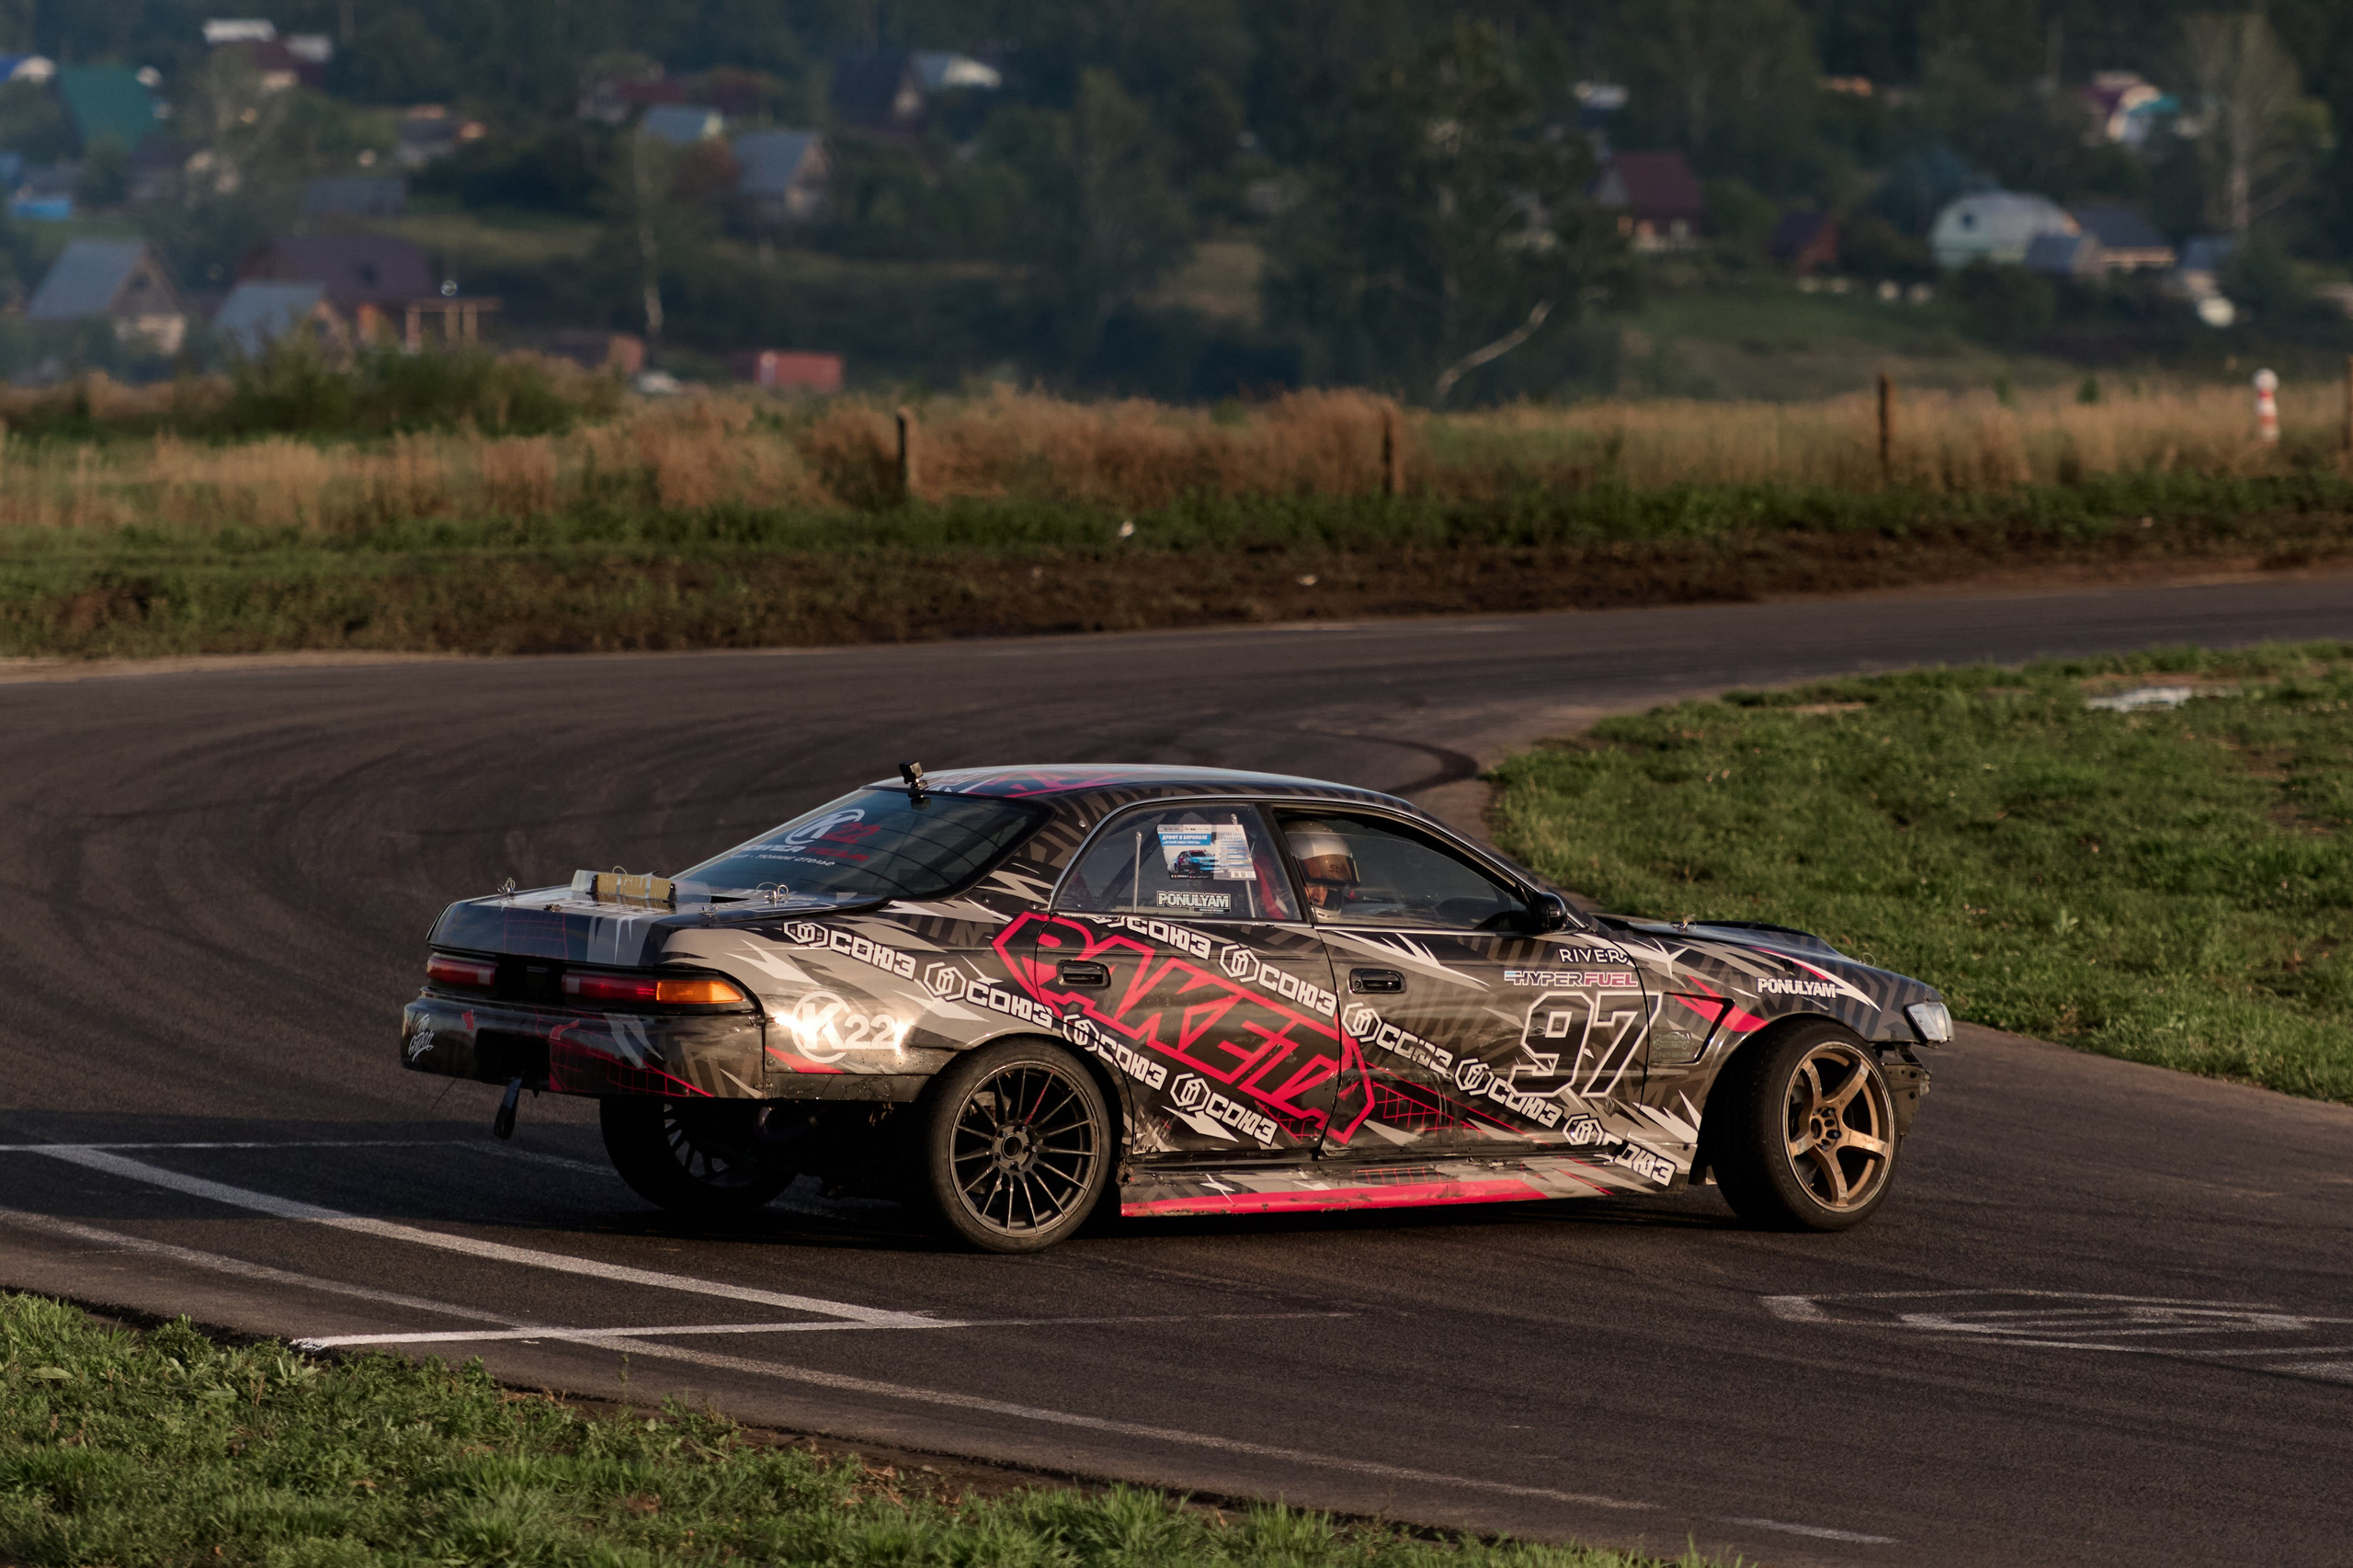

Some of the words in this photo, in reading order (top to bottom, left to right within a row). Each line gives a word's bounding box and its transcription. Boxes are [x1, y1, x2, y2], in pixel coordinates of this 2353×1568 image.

[1157, 892, 1230, 908] PONULYAM
[829, 931, 916, 980] СОЮЗ
[1558, 949, 1628, 964] RIVER
[965, 980, 1054, 1029] СОЮЗ
[1257, 964, 1337, 1018] СОЮЗ
[1756, 977, 1836, 998] PONULYAM
[1097, 1034, 1167, 1091] СОЮЗ
[1506, 991, 1664, 1098] 97
[1205, 1092, 1278, 1145] СОЮЗ
